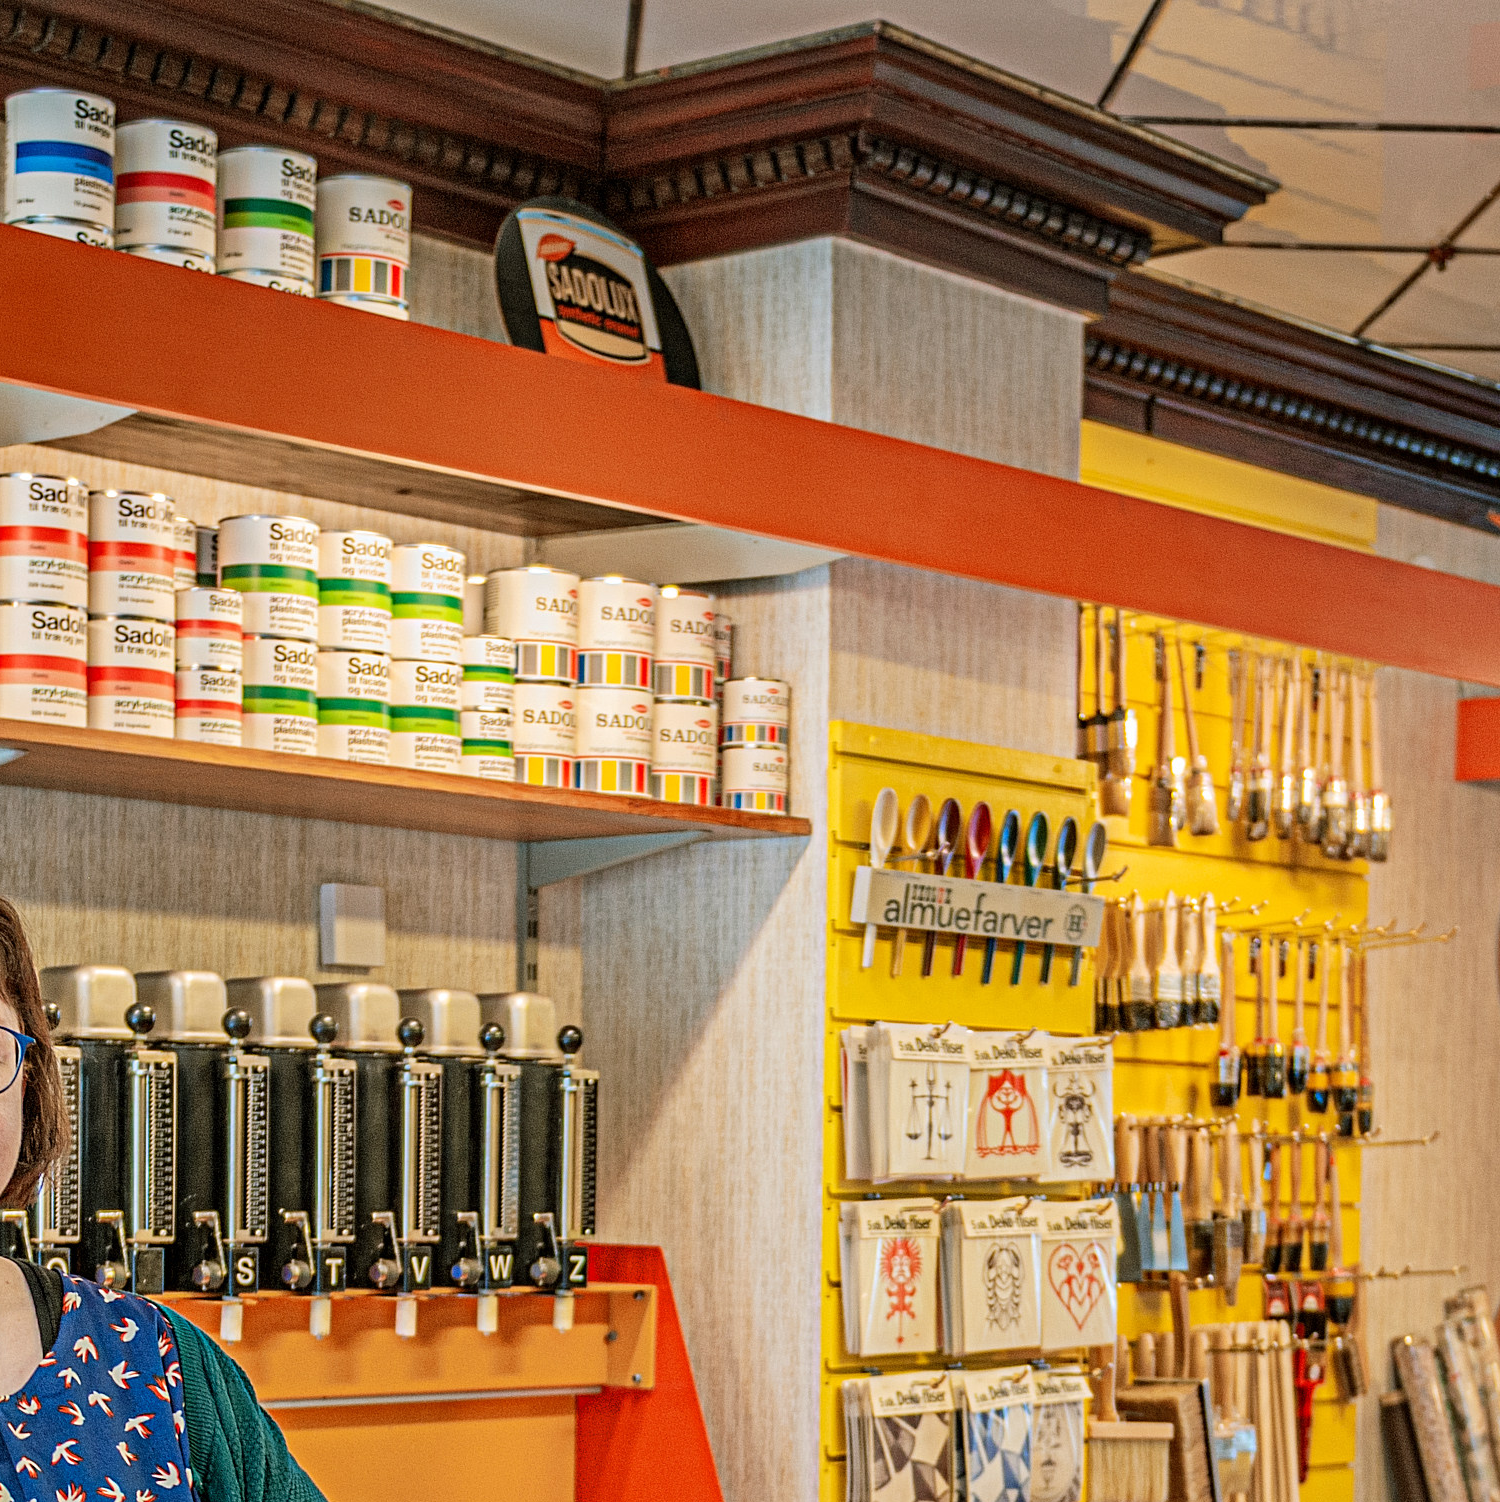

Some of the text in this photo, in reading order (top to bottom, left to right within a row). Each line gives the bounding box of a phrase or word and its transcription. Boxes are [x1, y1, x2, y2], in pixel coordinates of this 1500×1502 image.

[549, 261, 640, 325] SADOLUX
[884, 883, 1054, 939] almuefarver
[236, 1257, 255, 1285] S
[325, 1258, 343, 1285] T
[411, 1256, 430, 1283] V
[489, 1253, 514, 1281] W
[569, 1255, 586, 1282] Z
